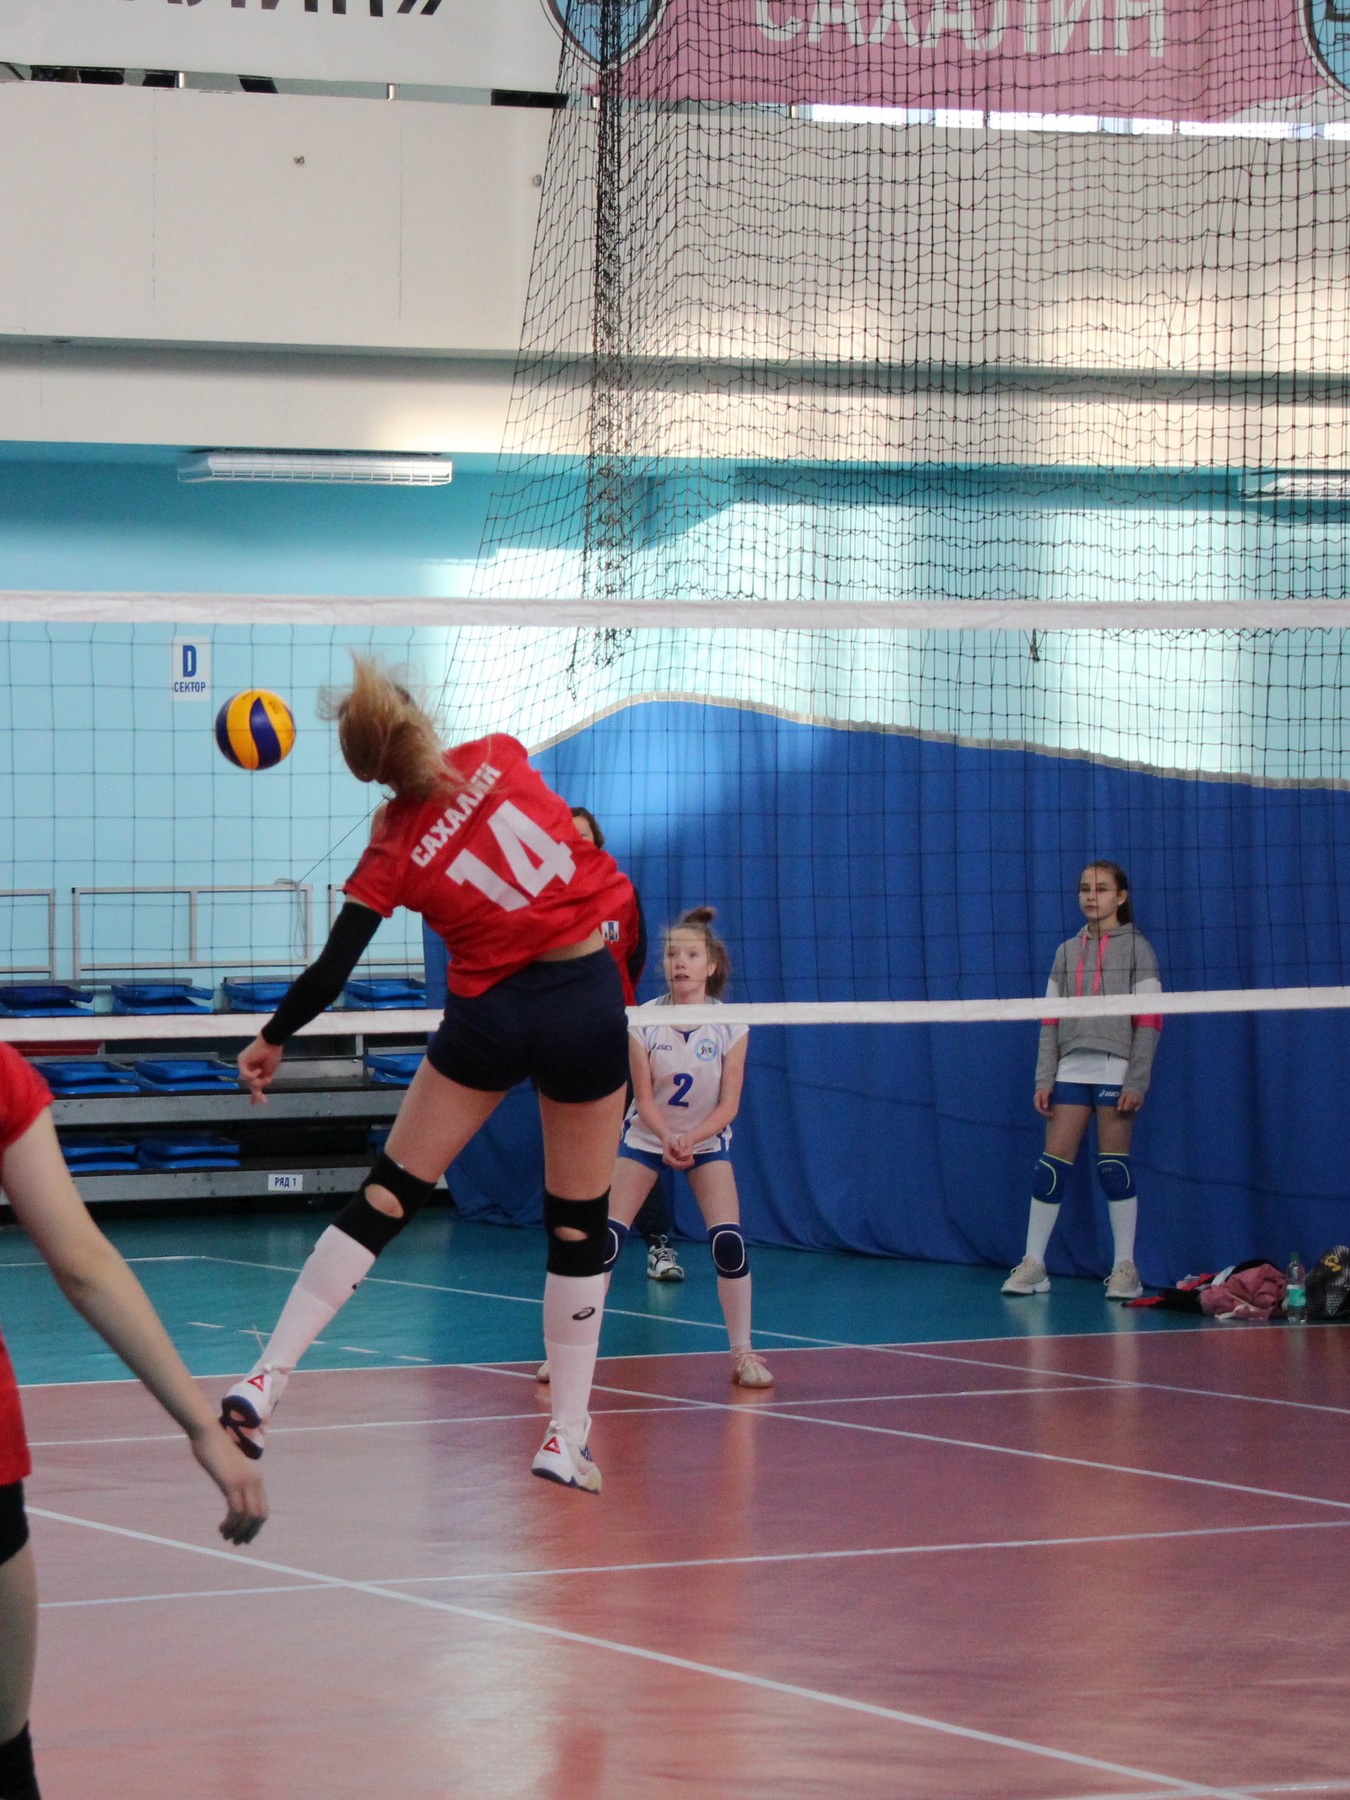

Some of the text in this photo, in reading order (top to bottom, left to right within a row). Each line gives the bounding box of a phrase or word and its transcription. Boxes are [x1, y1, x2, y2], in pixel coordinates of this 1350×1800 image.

[182, 645, 197, 678] D
[174, 681, 206, 693] СЕКТОР
[410, 762, 502, 868] САХАЛИН
[445, 800, 577, 912] 14
[667, 1072, 694, 1108] 2
[275, 1176, 297, 1188] РЯД 1
